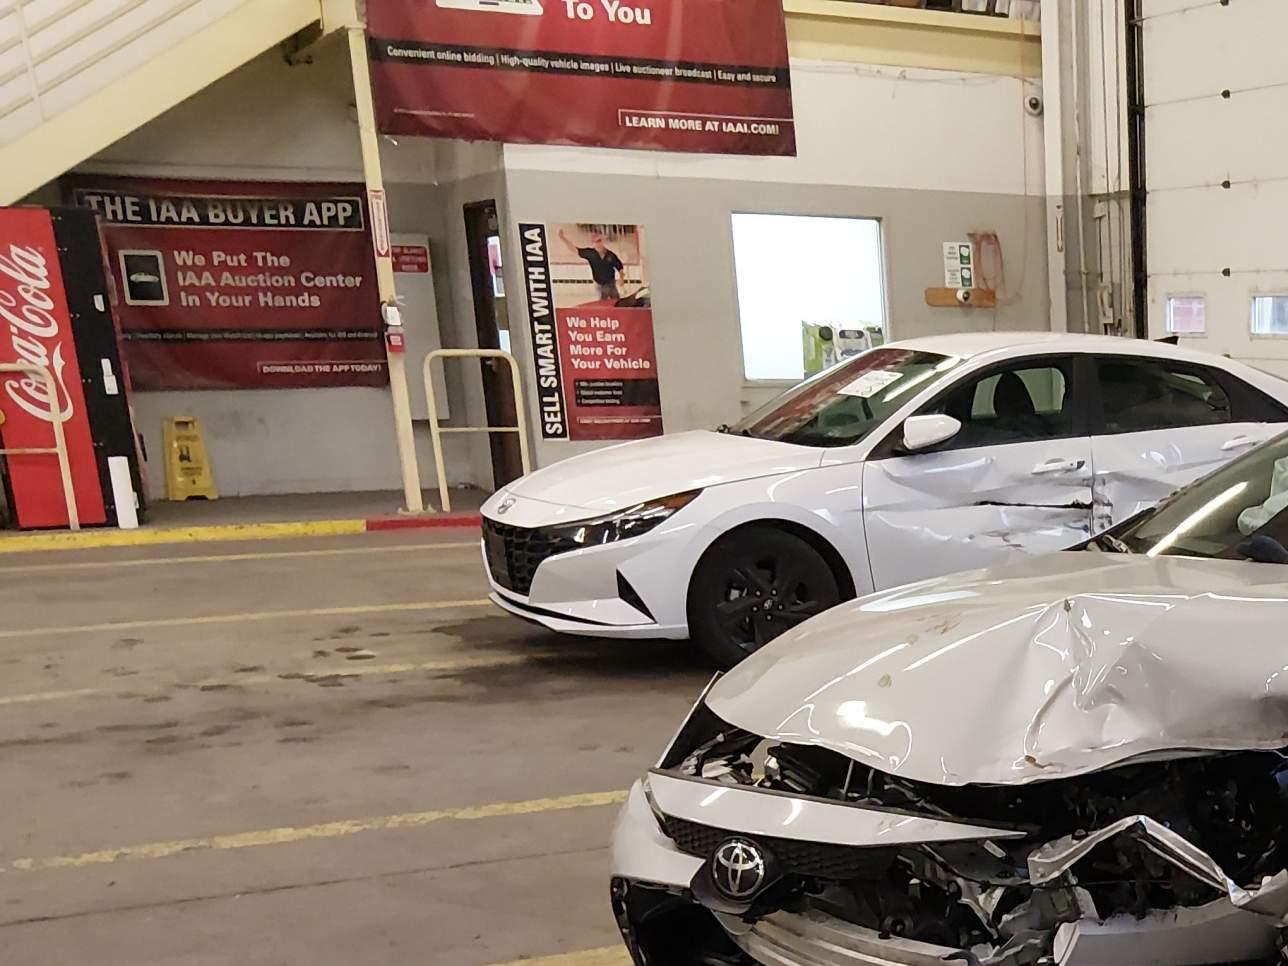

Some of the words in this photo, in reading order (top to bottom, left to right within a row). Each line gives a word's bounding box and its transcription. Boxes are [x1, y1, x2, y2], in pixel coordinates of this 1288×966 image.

[563, 0, 594, 20] To
[601, 0, 652, 25] You
[387, 45, 435, 59] Convenient
[436, 50, 462, 61] online
[463, 52, 495, 66] bidding
[500, 54, 549, 69] High-quality
[550, 58, 579, 70] vehicle
[579, 60, 610, 73] images
[615, 62, 631, 73] Live
[674, 66, 713, 79] broadcast
[717, 69, 736, 82] Easy
[736, 72, 752, 81] and
[625, 116, 665, 128] LEARN
[668, 118, 702, 131] MORE
[704, 120, 719, 131] AT
[85, 195, 142, 221] THE
[148, 199, 205, 223] IAA
[208, 200, 296, 225] BUYER
[303, 202, 353, 226] APP
[524, 227, 544, 261] IAA
[173, 250, 206, 267] We
[213, 251, 247, 267] Put
[253, 251, 290, 267] The
[177, 271, 216, 287] IAA
[220, 271, 298, 288] Auction
[301, 272, 363, 288] Center
[180, 291, 201, 307] In
[205, 291, 252, 307] Your
[258, 291, 321, 307] Hands
[528, 266, 550, 318] WITH
[566, 316, 587, 328] We
[590, 316, 619, 331] Help
[568, 330, 593, 342] You
[596, 331, 625, 343] Earn
[535, 321, 557, 388] SMART
[569, 344, 603, 356] More
[606, 344, 628, 356] For
[571, 358, 601, 370] Your
[604, 358, 650, 370] Vehicle
[545, 392, 562, 434] SELL
